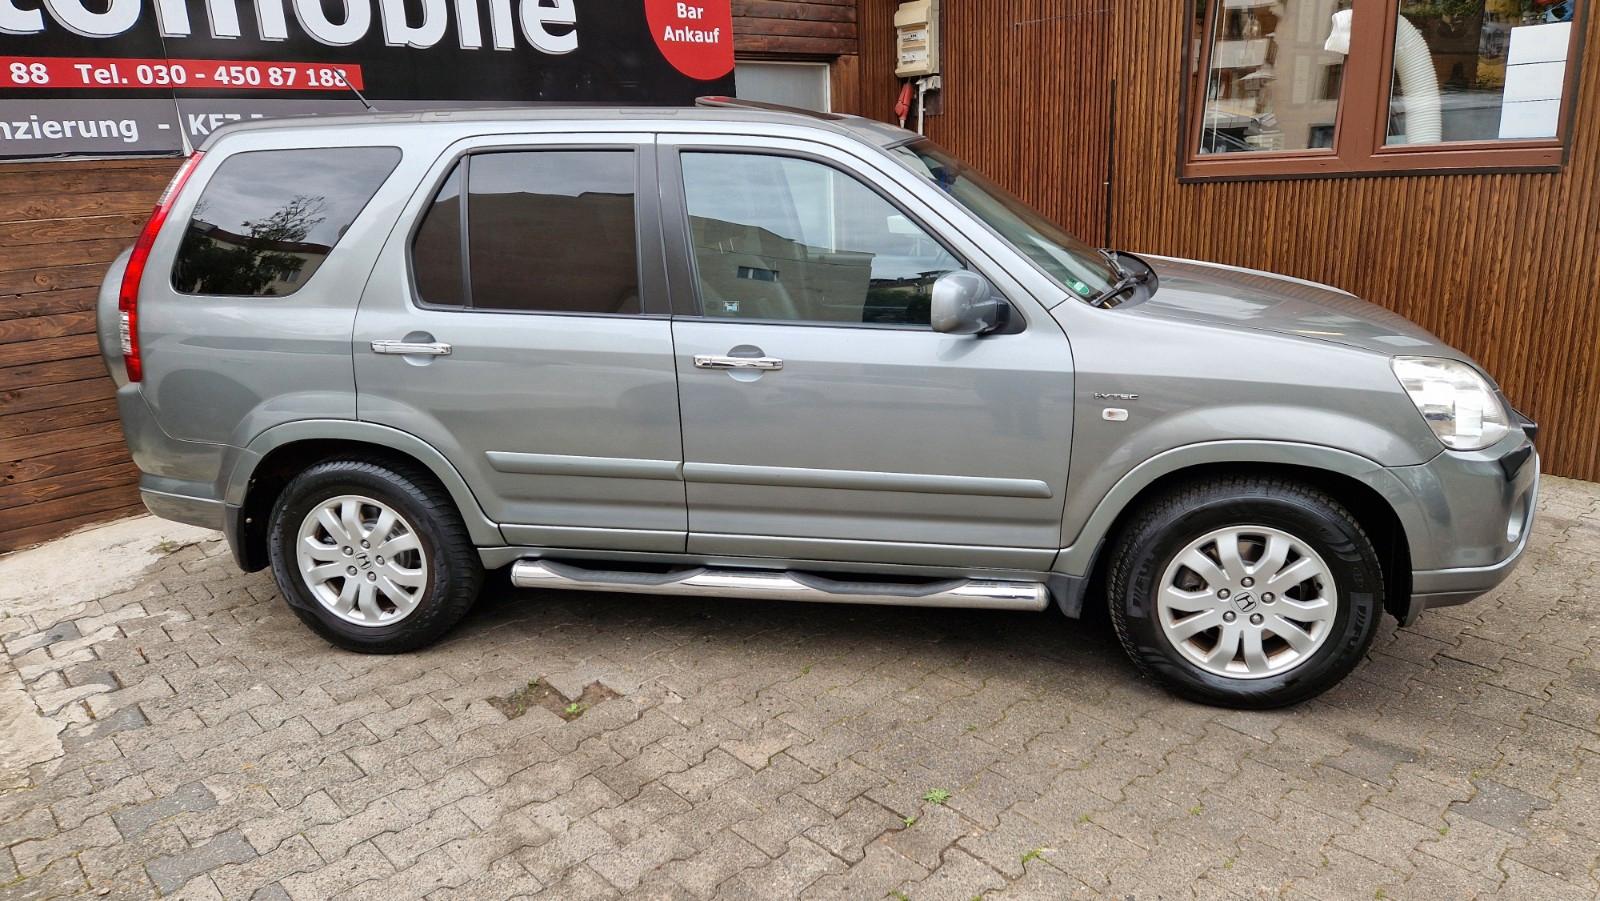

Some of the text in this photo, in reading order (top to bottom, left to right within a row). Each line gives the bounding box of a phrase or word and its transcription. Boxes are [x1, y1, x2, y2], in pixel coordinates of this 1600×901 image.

[676, 2, 704, 19] Bar
[663, 25, 720, 43] Ankauf
[9, 62, 49, 84] 88
[74, 64, 129, 84] Tel.
[136, 65, 187, 84] 030
[213, 66, 261, 85] 450
[268, 67, 296, 86] 87
[305, 69, 347, 87] 188
[188, 114, 241, 135] KF
